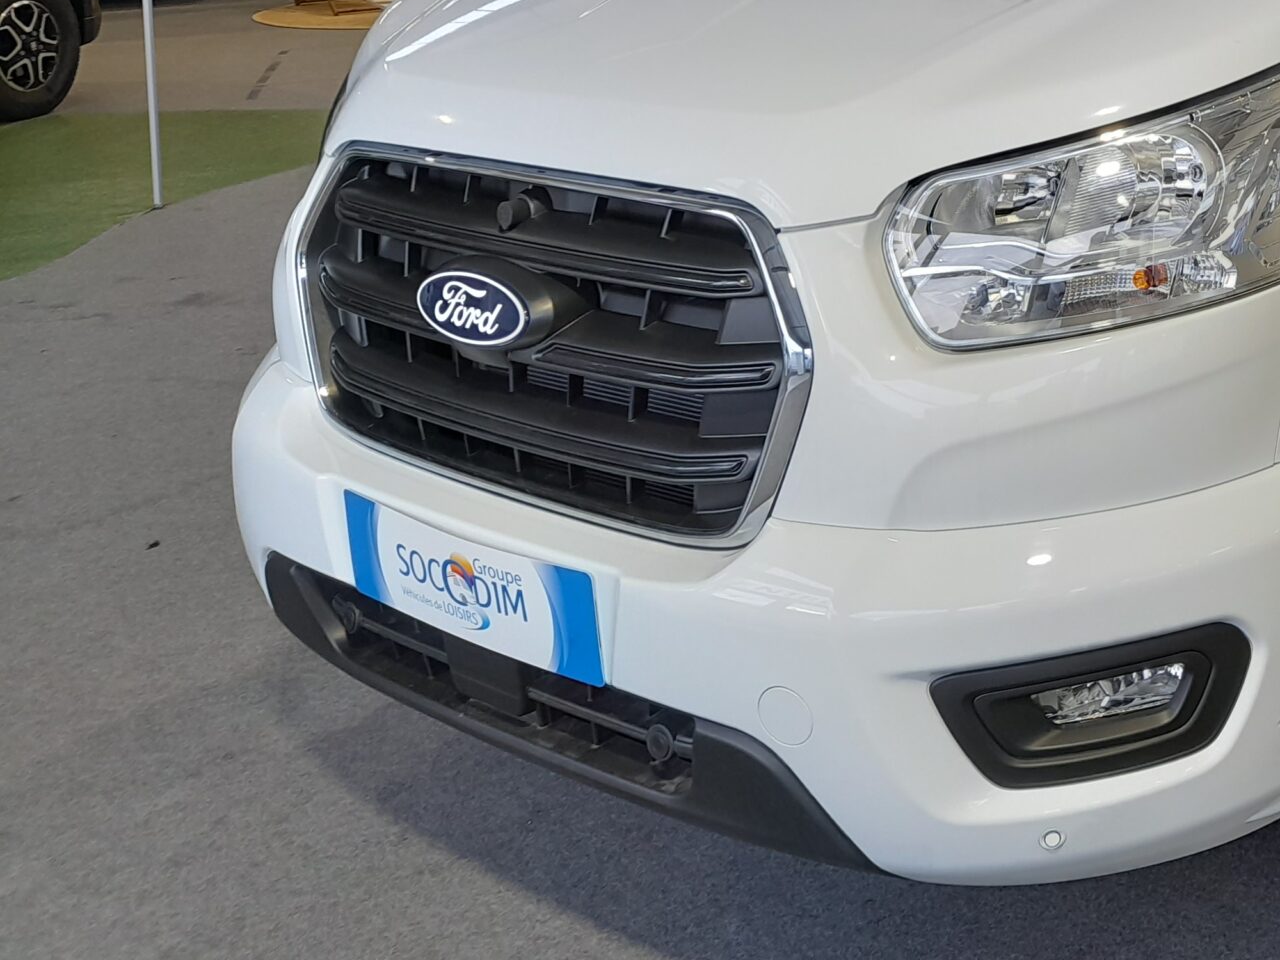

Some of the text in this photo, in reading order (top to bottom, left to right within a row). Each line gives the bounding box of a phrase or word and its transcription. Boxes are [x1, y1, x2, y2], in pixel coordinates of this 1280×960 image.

[434, 280, 503, 335] Ford
[472, 557, 523, 588] Groupe
[442, 601, 479, 627] LOISIRS
